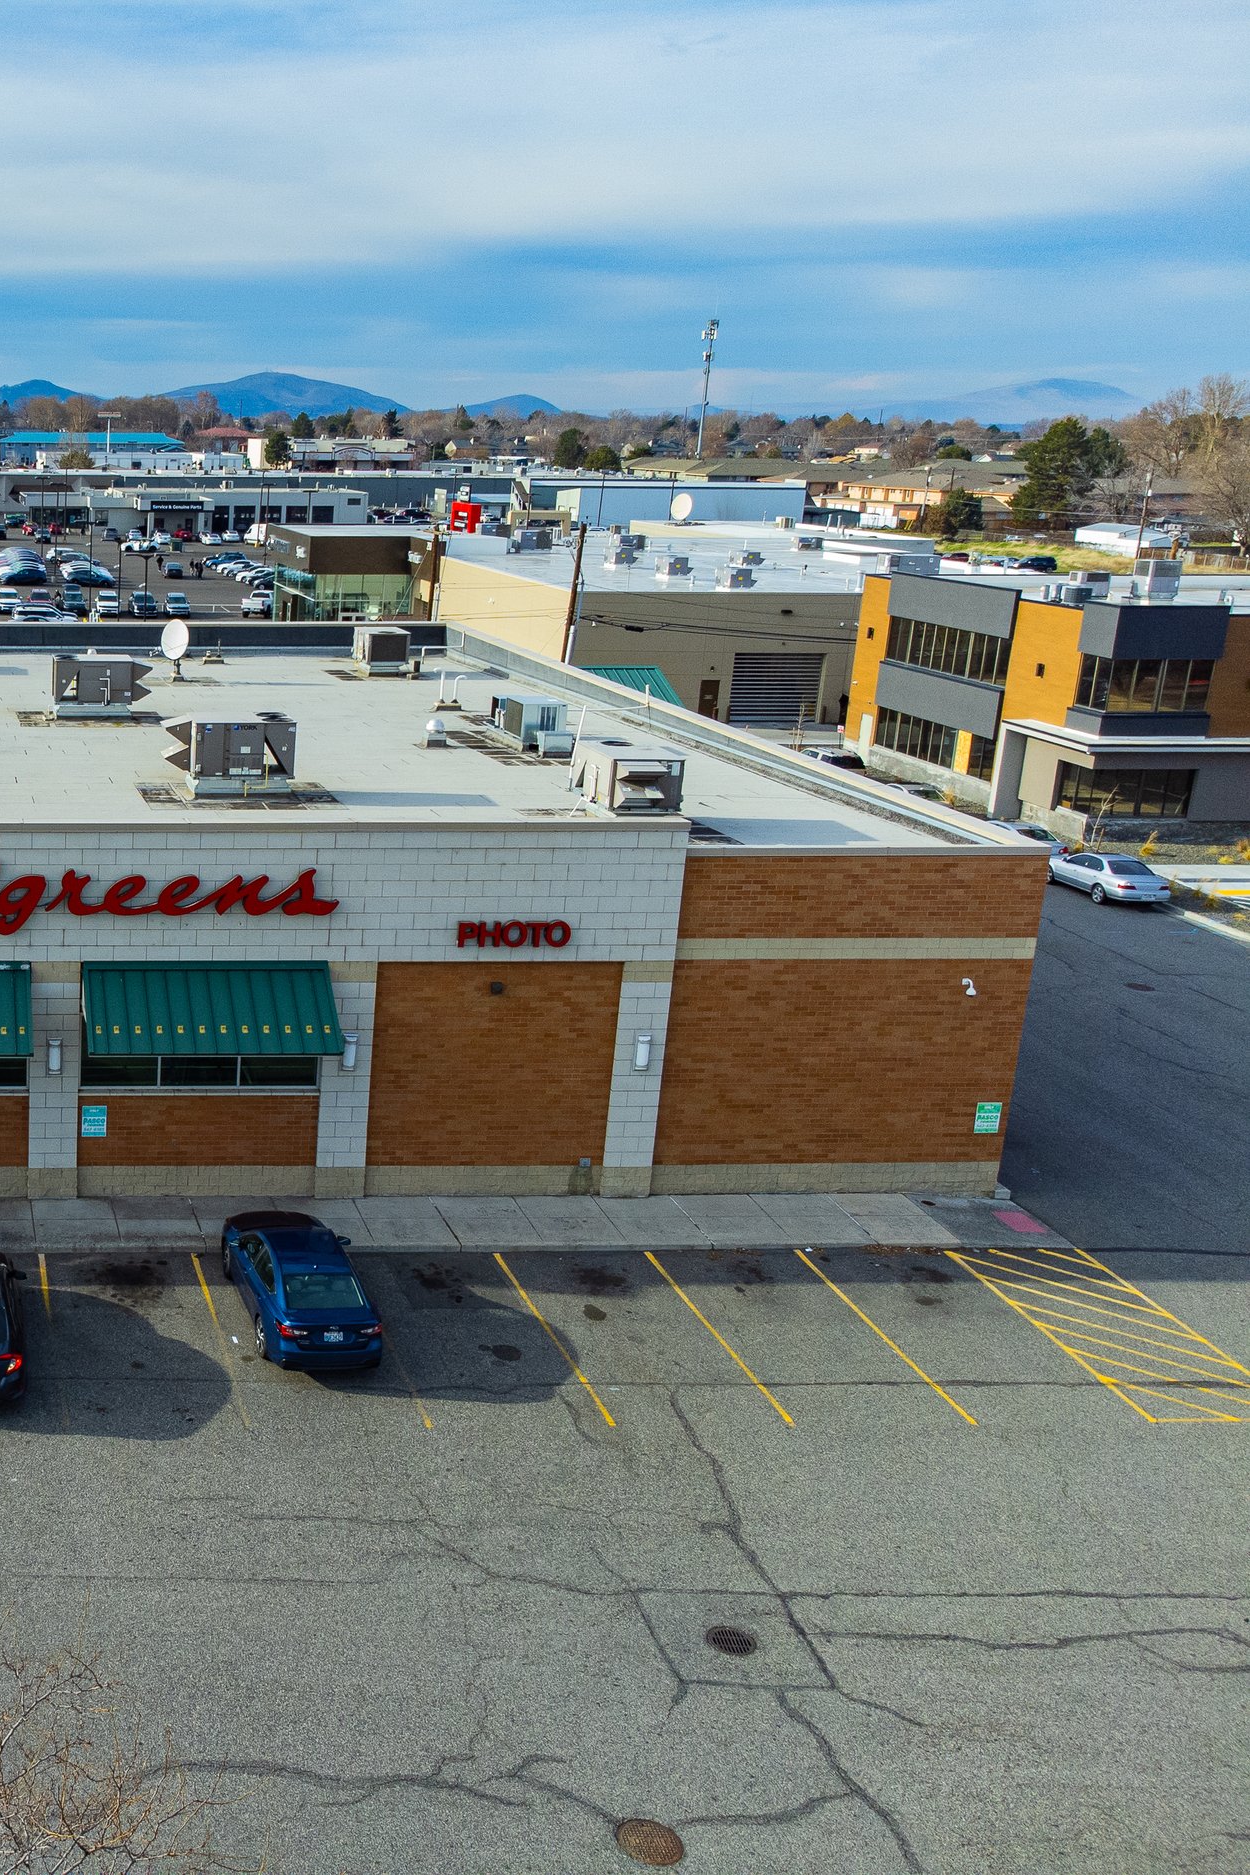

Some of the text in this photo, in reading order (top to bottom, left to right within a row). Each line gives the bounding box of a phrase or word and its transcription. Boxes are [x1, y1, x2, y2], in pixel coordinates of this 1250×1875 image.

[240, 723, 258, 731] YORK
[456, 919, 572, 948] PHOTO
[83, 1117, 106, 1125] PASCO
